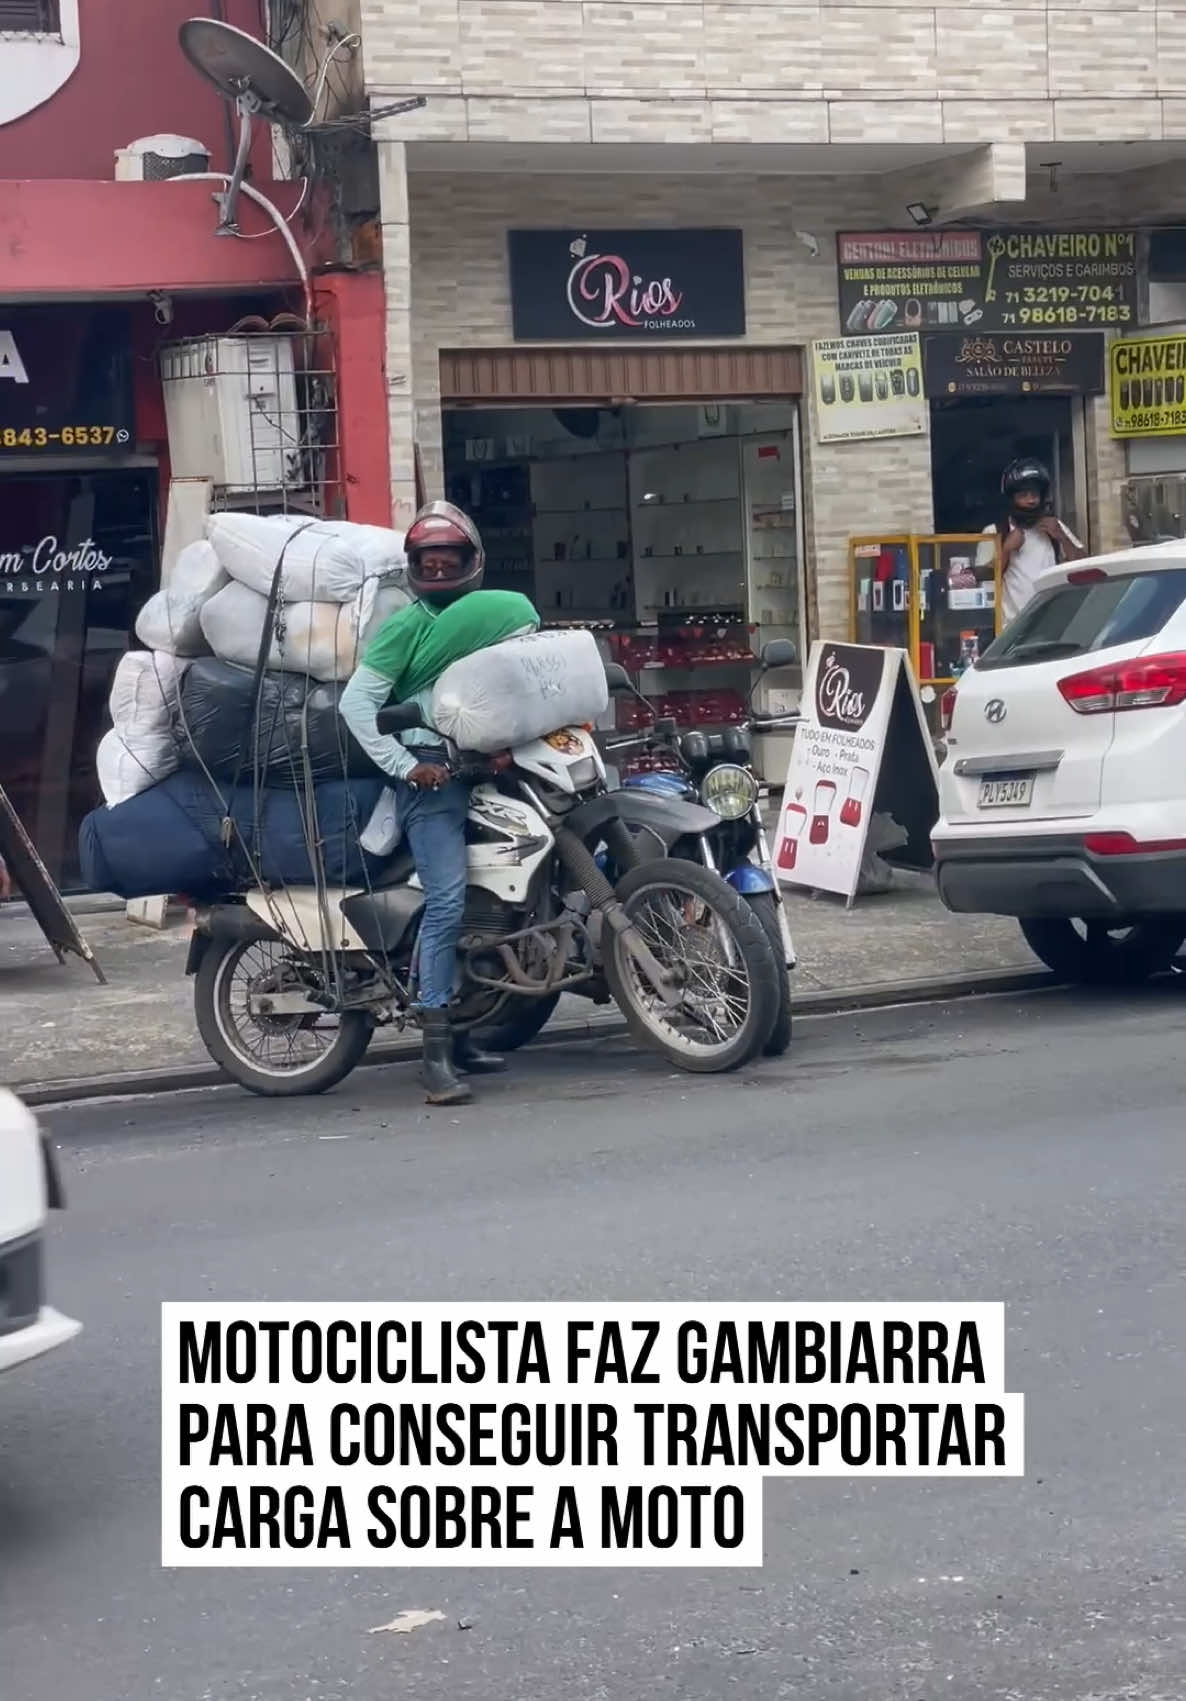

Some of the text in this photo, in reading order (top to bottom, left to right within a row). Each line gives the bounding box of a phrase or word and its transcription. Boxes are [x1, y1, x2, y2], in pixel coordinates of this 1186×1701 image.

[1006, 233, 1100, 258] CHAVEIRO
[843, 267, 875, 280] VENDAS
[876, 267, 886, 280] DE
[937, 265, 947, 278] DE
[948, 264, 980, 278] CELULAR
[1008, 263, 1065, 280] SERVIÇOS
[1066, 263, 1074, 277] E
[576, 255, 683, 326] Rios
[863, 284, 869, 296] E
[870, 282, 911, 296] PRODUTOS
[1005, 283, 1125, 303] 71 3219-7041
[1002, 305, 1131, 324] 71 98618-7183
[643, 319, 697, 329] FOLHEADOS
[1003, 339, 1073, 354] CASTELO
[966, 363, 1002, 377] SALÃO
[1003, 365, 1020, 377] DE
[33, 535, 113, 574] Cortes
[824, 666, 866, 720] Rios
[801, 728, 875, 751] TUDO EM FOLHEADOS
[812, 744, 860, 762] Ouro Prata
[817, 761, 848, 776] Aço Inox
